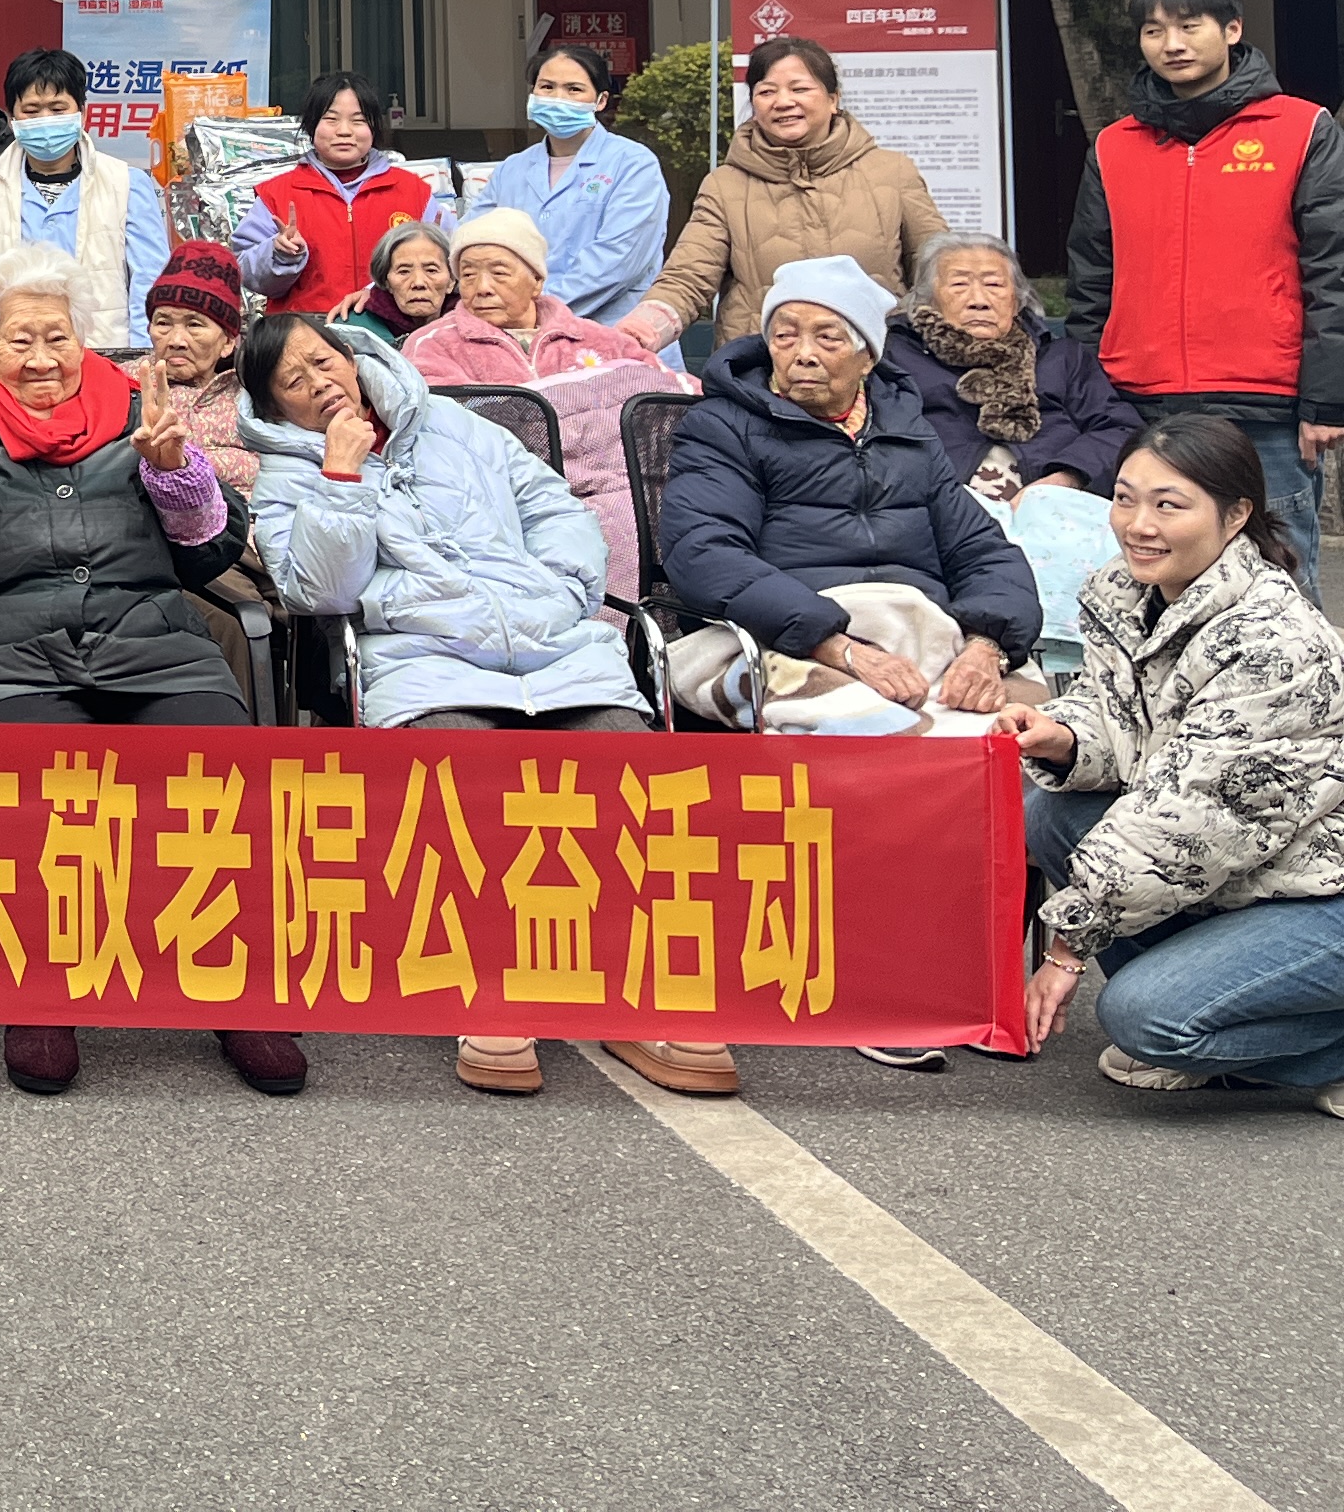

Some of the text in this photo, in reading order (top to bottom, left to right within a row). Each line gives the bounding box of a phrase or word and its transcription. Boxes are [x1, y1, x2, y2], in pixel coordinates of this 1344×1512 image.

[565, 14, 624, 33] 消火栓
[846, 7, 937, 24] 四百年马应龙
